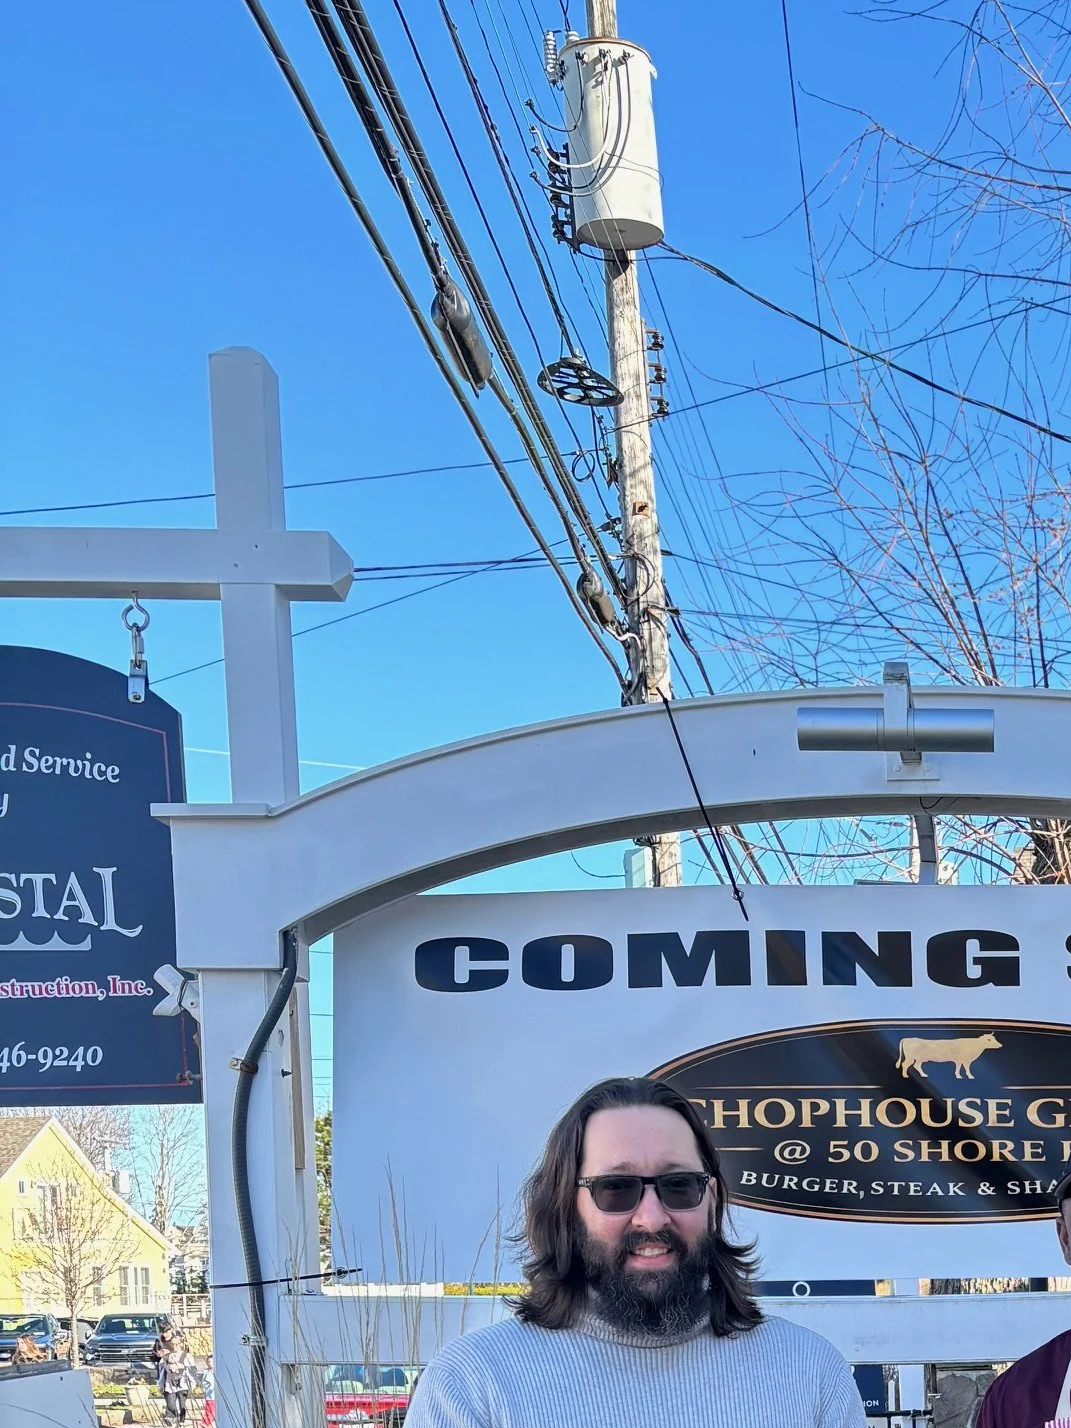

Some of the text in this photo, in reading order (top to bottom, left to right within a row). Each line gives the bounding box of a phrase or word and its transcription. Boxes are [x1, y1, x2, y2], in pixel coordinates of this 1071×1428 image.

[22, 747, 120, 783] Service
[415, 929, 1020, 992] COMING
[108, 975, 153, 996] Inc.
[774, 1140, 811, 1165] @
[827, 1140, 879, 1163] 50
[894, 1139, 1046, 1162] SHORE
[870, 1181, 966, 1196] STEAK
[977, 1181, 996, 1196] &
